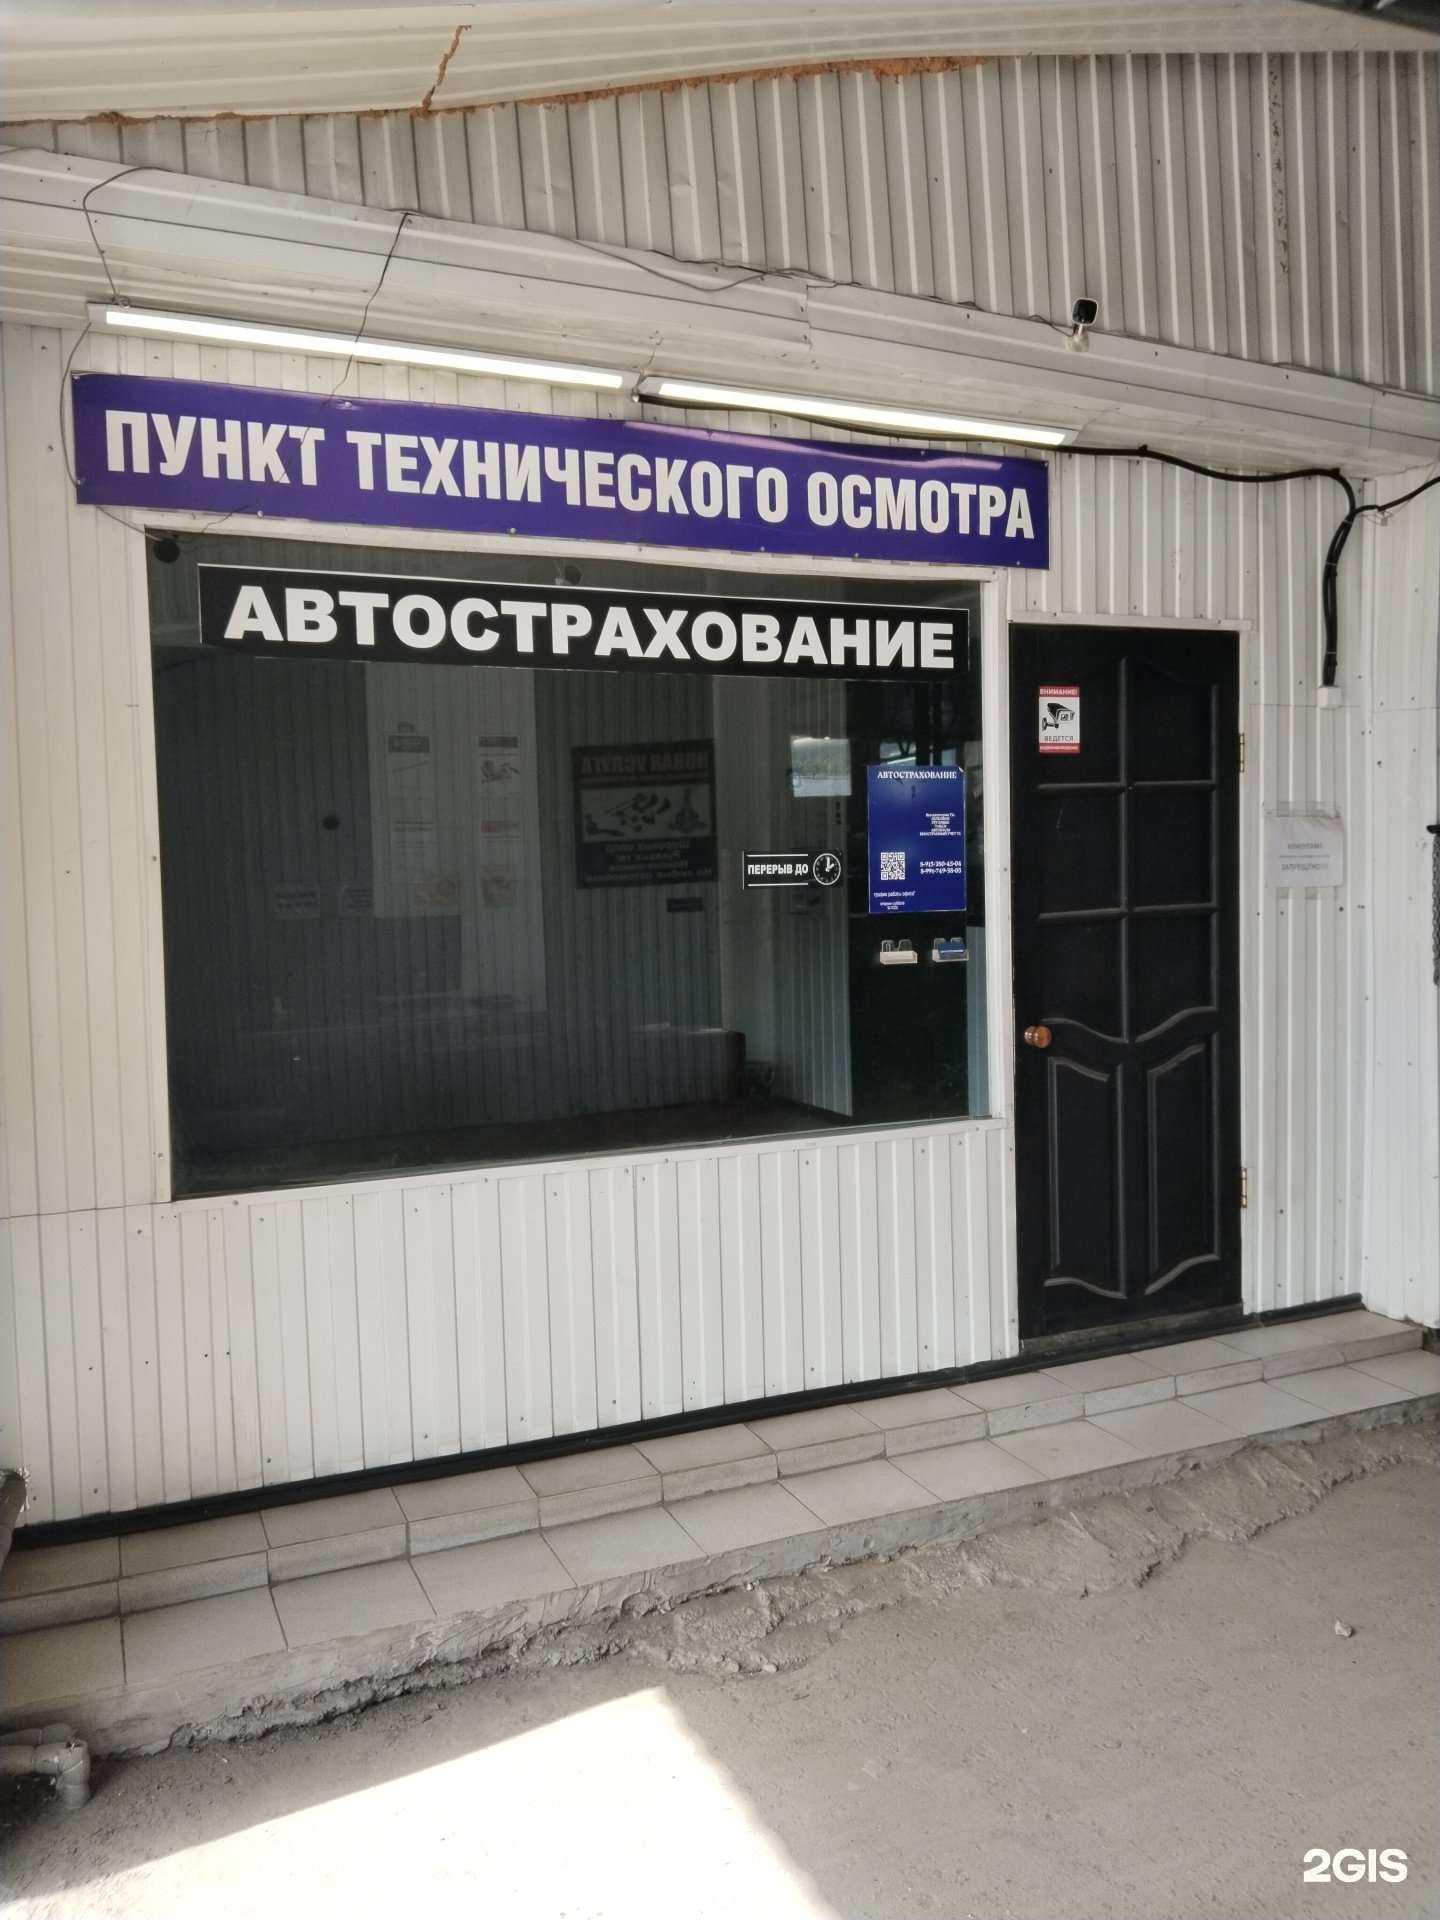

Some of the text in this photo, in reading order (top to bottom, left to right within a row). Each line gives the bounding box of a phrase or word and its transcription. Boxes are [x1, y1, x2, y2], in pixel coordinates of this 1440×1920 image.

[105, 409, 1035, 540] ПУНКТ ТЕХНИЧЕСКОГО ОСМОТРА
[224, 585, 955, 670] АВТОСТРАХОВАНИЕ
[877, 770, 957, 779] АВТОСТРАХОВАНИЕ
[747, 863, 809, 876] ПЕРЕРЫВ ДО
